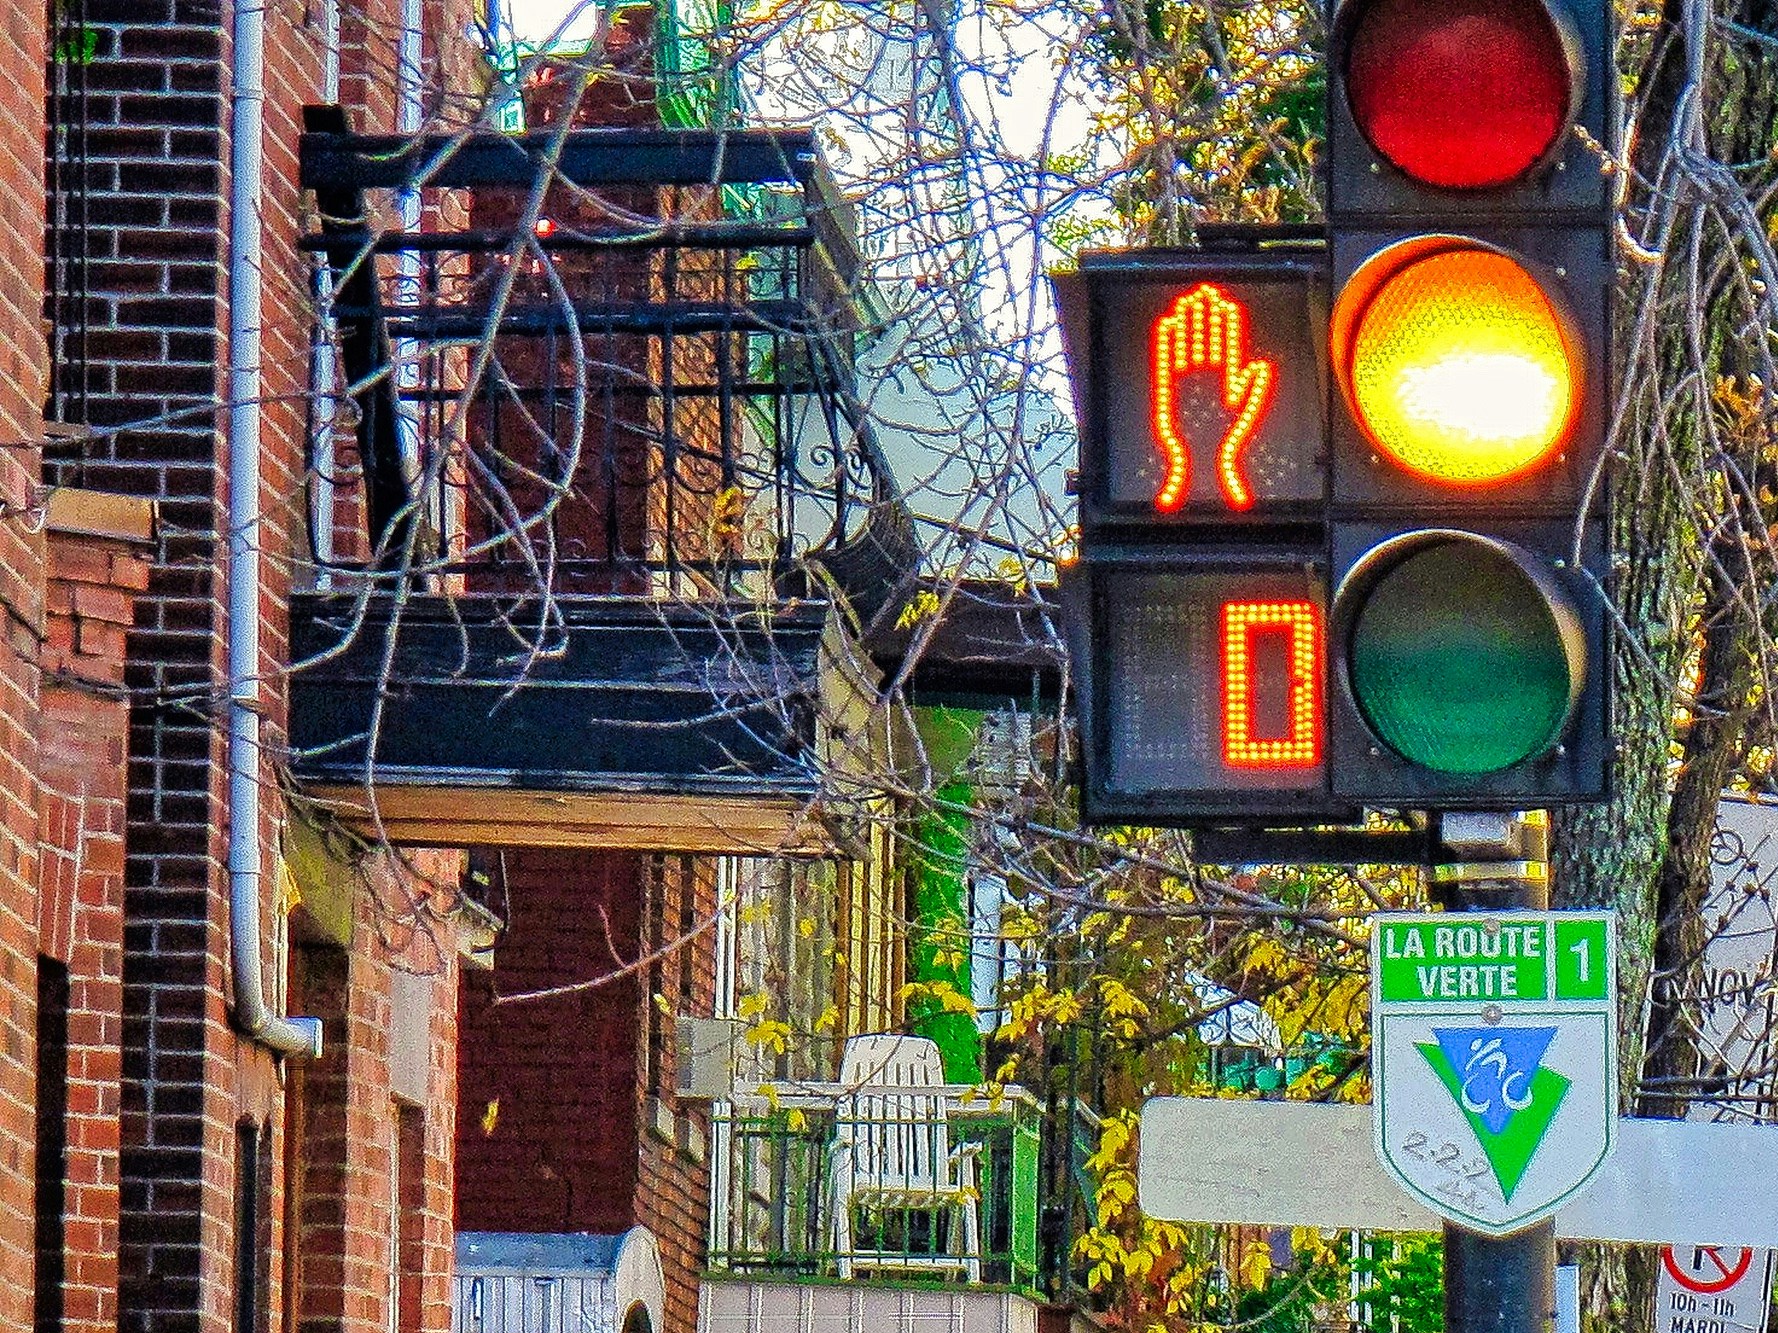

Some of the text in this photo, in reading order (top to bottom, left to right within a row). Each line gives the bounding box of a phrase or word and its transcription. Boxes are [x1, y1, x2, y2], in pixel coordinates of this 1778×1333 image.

[1384, 925, 1541, 959] LA ROUTE
[1570, 938, 1590, 982] 1
[1417, 965, 1518, 997] VERTE
